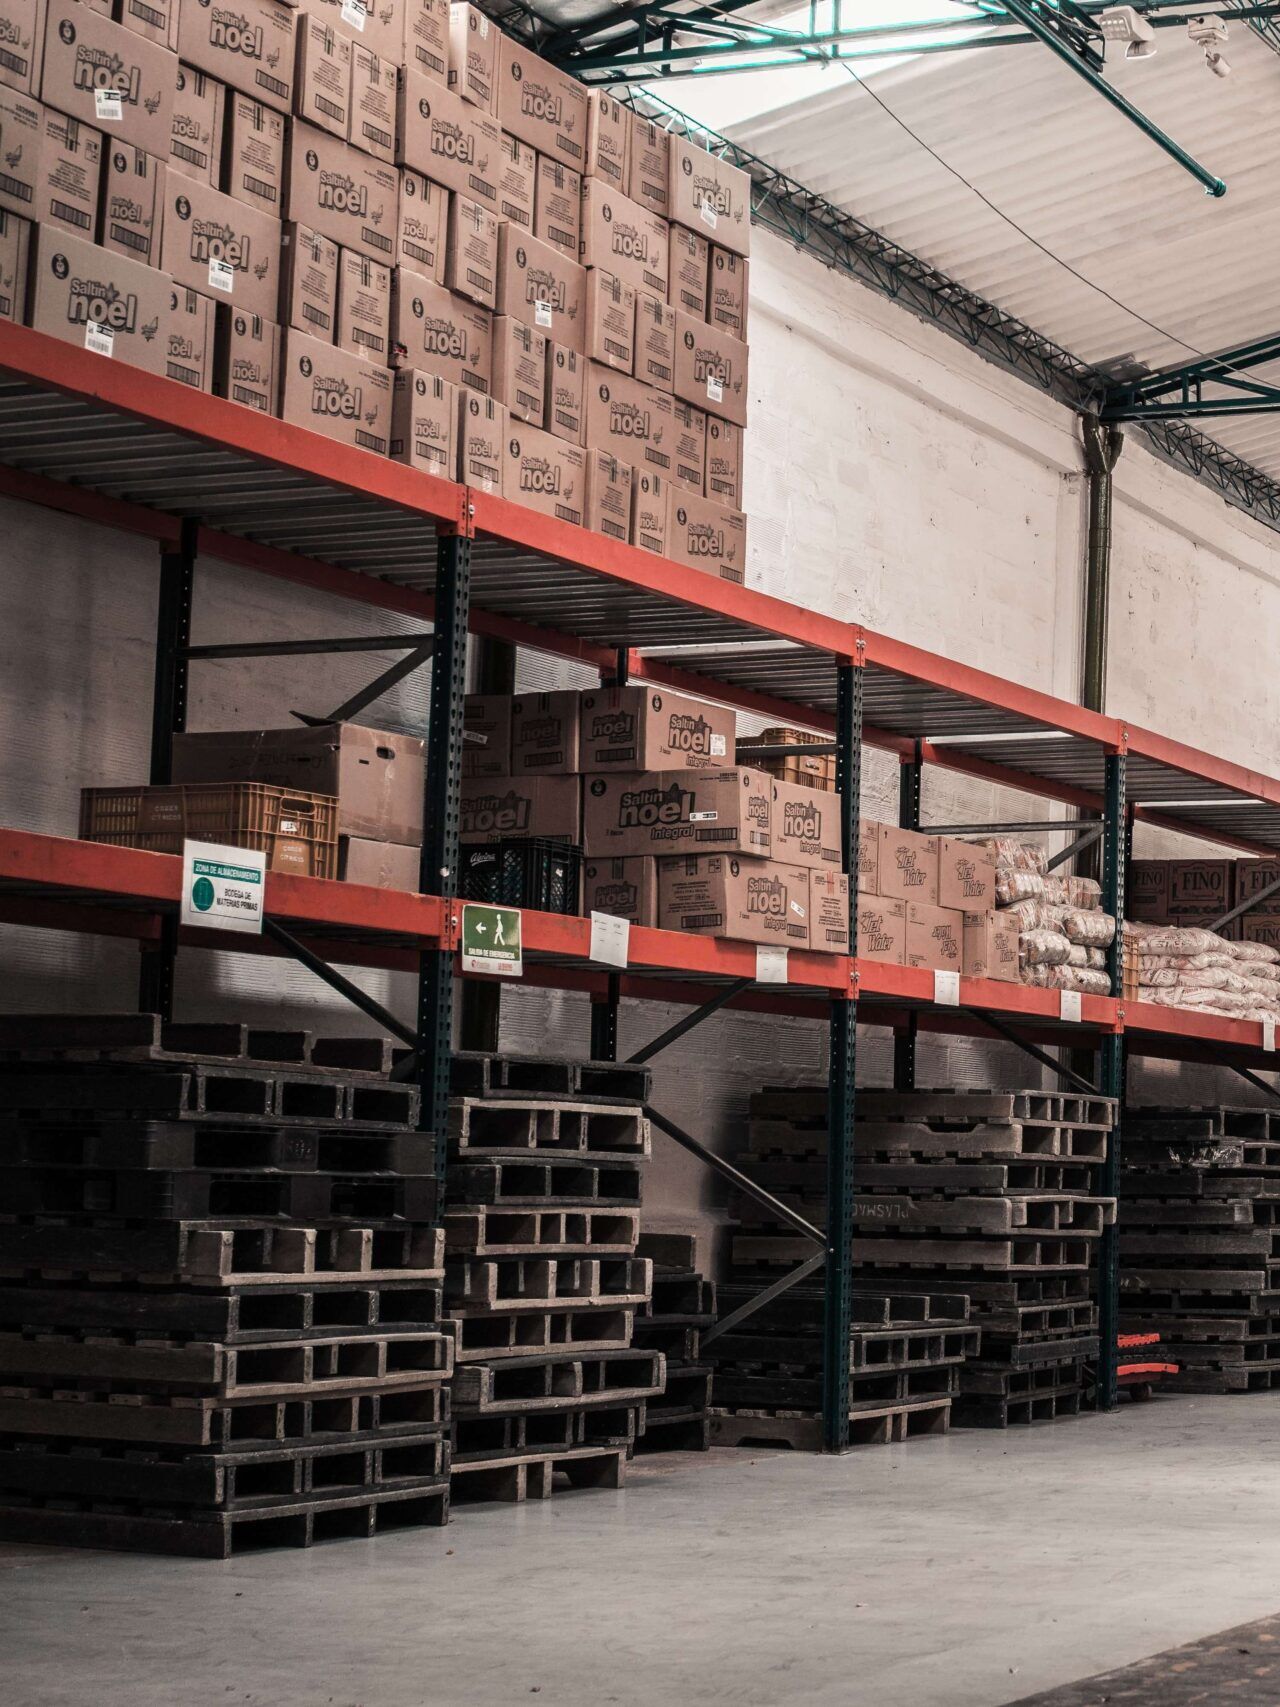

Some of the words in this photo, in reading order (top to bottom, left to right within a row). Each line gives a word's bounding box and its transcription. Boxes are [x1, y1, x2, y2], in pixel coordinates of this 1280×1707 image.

[212, 8, 240, 28] Saltin
[210, 21, 263, 60] noel
[76, 44, 112, 67] Saltin
[74, 59, 141, 106] noel
[523, 81, 546, 99] Saltin
[521, 90, 562, 126] noel
[172, 120, 199, 140] noel
[431, 118, 456, 138] Saltin
[431, 129, 475, 165] noel
[320, 170, 345, 190] Saltin
[319, 181, 367, 218] noel
[693, 185, 732, 218] noel
[110, 203, 142, 223] noel
[192, 219, 224, 239] Saltin
[402, 222, 428, 242] noel
[190, 234, 250, 272] noel
[612, 233, 648, 263] noel
[70, 278, 106, 298] Saltin
[525, 278, 566, 313] noel
[68, 294, 138, 334] noel
[424, 326, 466, 360] noel
[232, 362, 260, 383] noel
[694, 358, 731, 388] noel
[313, 375, 341, 392] Saltin
[312, 386, 362, 420] noel
[415, 423, 440, 439] noel
[610, 410, 650, 440] noel
[468, 442, 492, 458] noel
[520, 462, 561, 495] noel
[687, 530, 724, 558] noel
[521, 718, 561, 743] noel
[592, 715, 633, 737] noel
[670, 714, 696, 731] Saltin
[668, 723, 712, 755] noel
[622, 789, 664, 808] Saltin
[785, 801, 806, 817] Saltin
[460, 800, 531, 831] noel
[619, 791, 696, 828] noel
[748, 804, 768, 820] noel
[651, 825, 695, 842] Integral
[784, 811, 821, 840] noel
[800, 841, 821, 855] Integral
[195, 863, 209, 873] ZONA
[210, 865, 217, 874] DE
[1135, 871, 1163, 886] FINO
[748, 877, 772, 893] Saltin
[1182, 870, 1222, 891] FINO
[216, 898, 240, 909] MATERIAS
[240, 901, 258, 911] PRIMAS
[225, 888, 244, 899] BODEGA
[244, 891, 252, 900] DE
[747, 886, 788, 916] noel
[764, 917, 787, 931] Integral
